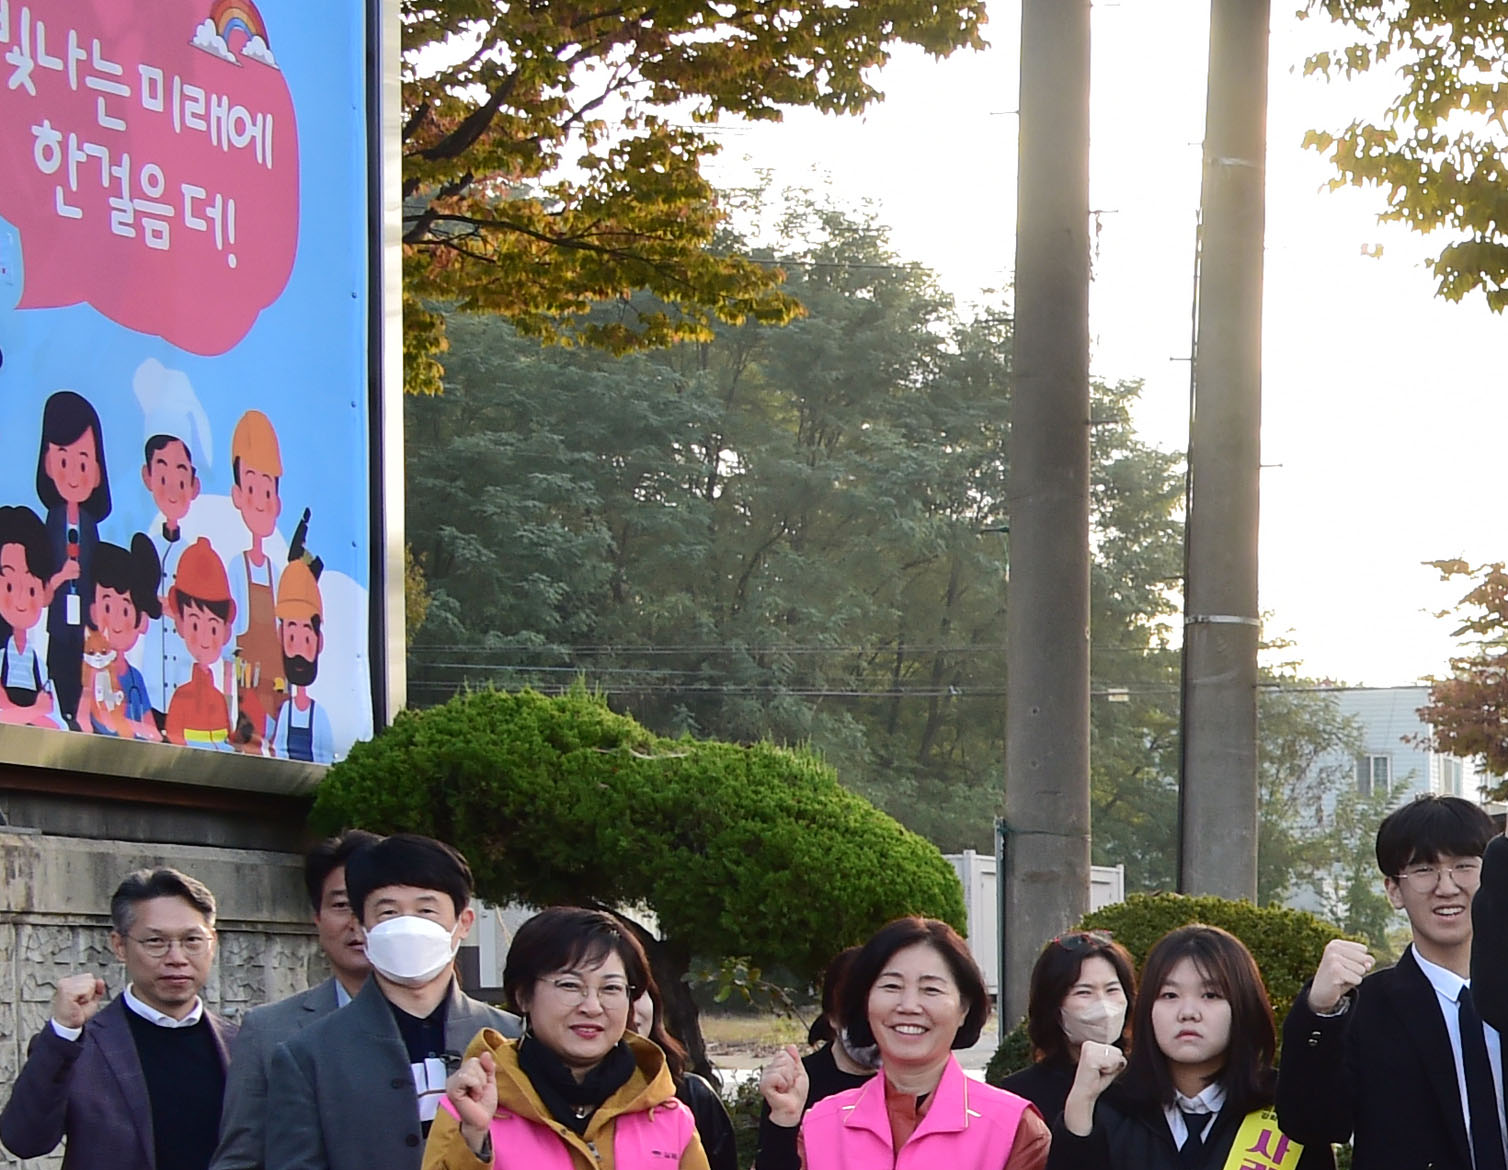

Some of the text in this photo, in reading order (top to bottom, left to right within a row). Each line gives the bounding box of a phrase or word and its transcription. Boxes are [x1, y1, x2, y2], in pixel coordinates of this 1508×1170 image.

[138, 64, 273, 170] 미래에
[31, 119, 237, 268] 한걸음 더!
